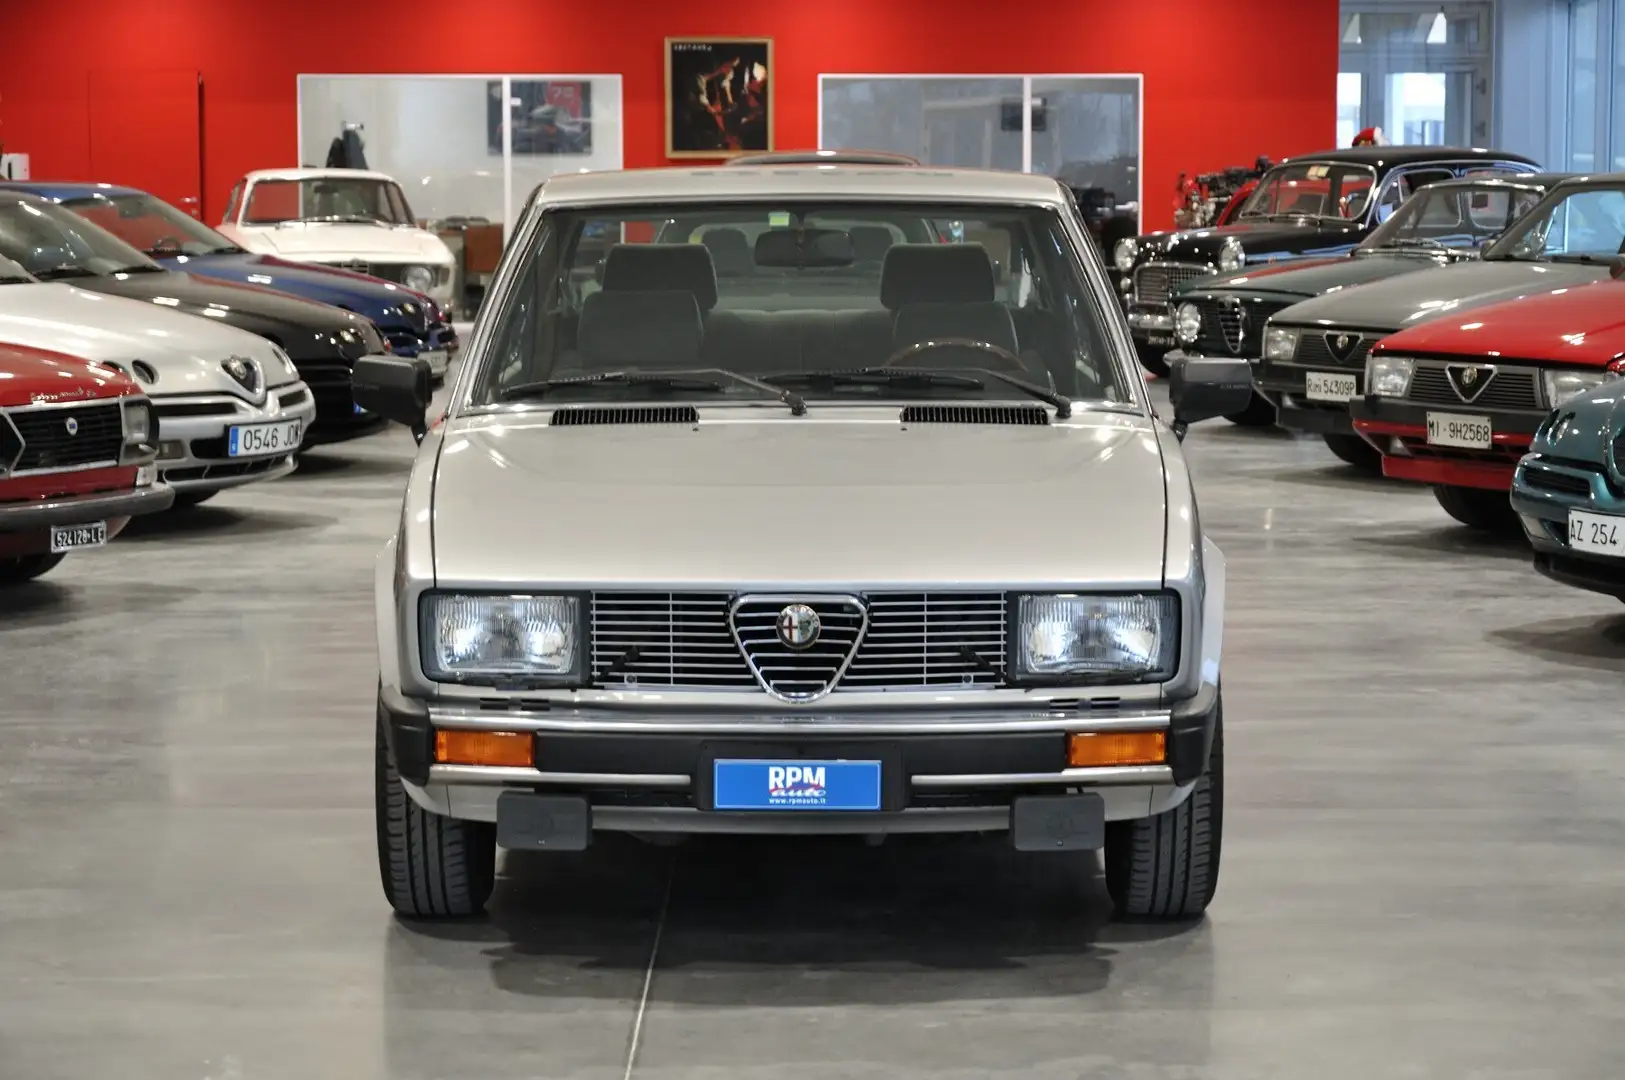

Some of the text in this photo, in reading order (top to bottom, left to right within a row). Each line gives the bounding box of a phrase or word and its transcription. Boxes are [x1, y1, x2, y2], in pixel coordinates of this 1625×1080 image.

[243, 428, 278, 450] 0546
[1570, 519, 1617, 546] AZ 254
[769, 766, 825, 790] RPM
